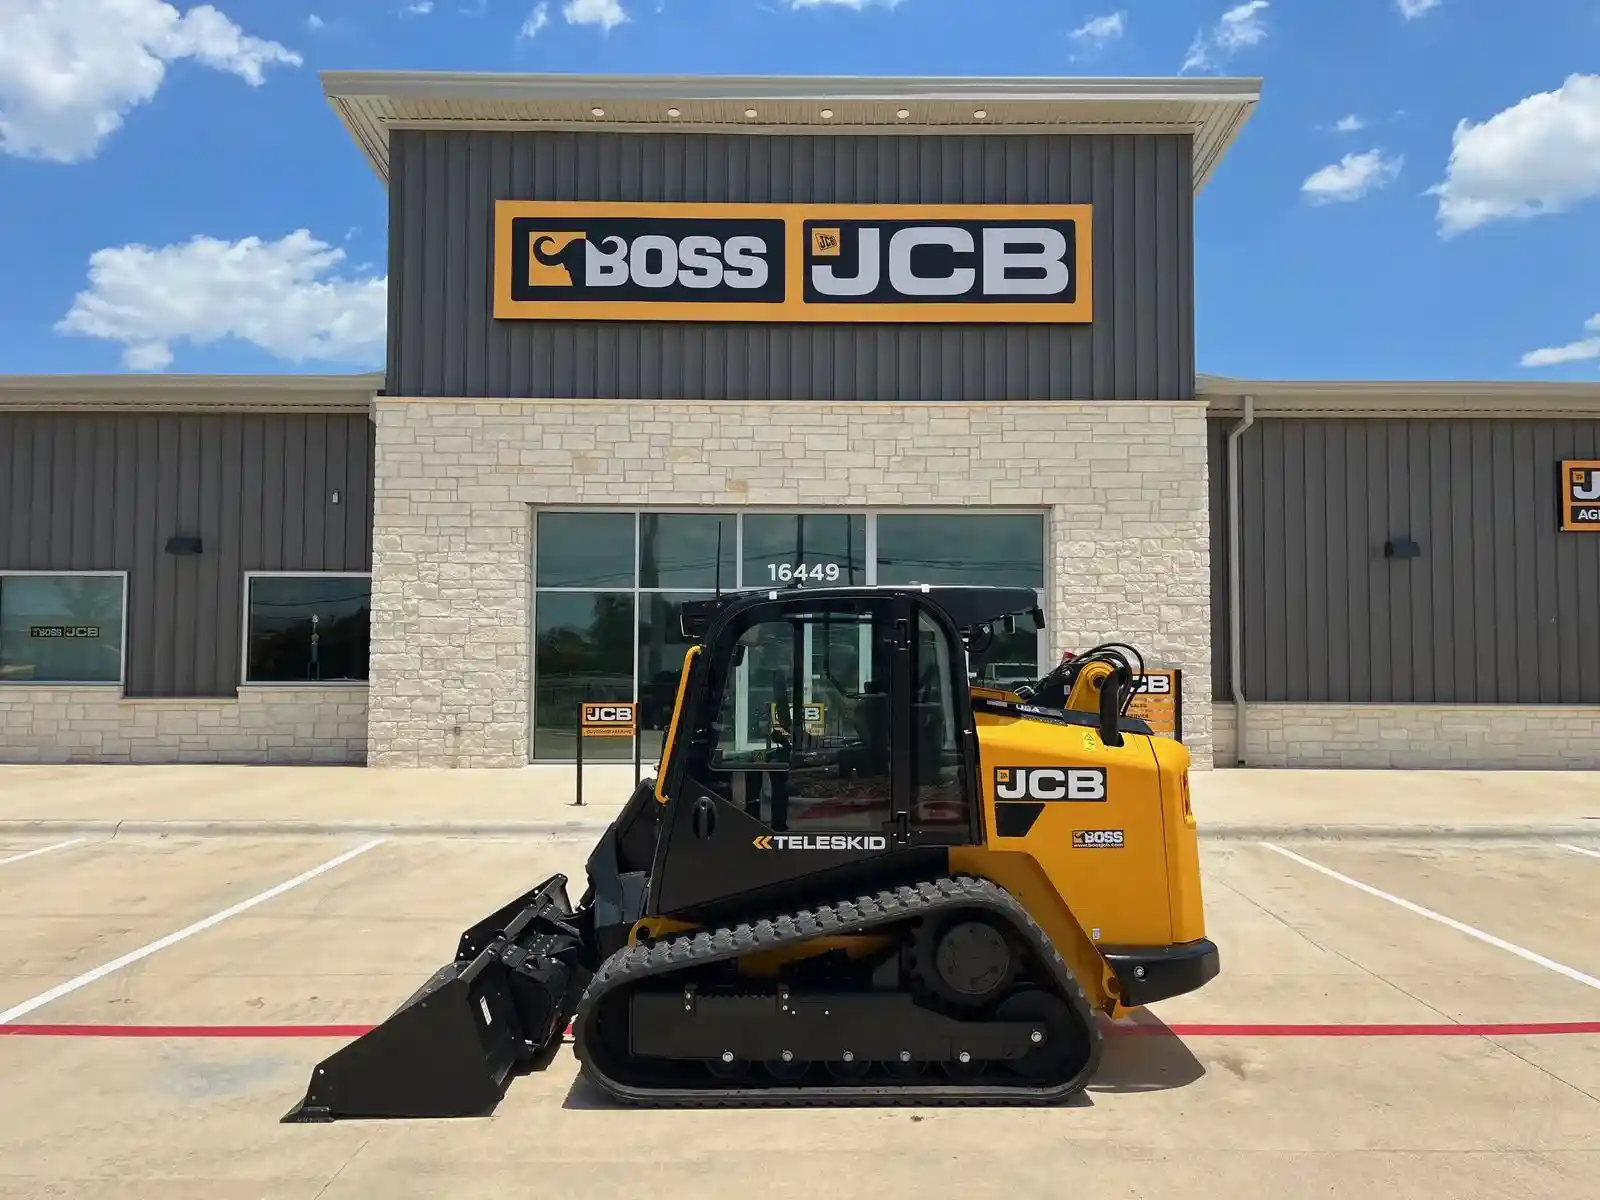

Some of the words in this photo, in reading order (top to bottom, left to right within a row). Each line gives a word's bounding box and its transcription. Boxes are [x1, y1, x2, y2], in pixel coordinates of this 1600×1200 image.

[585, 235, 769, 289] BOSS
[811, 227, 1069, 297] JCB
[1578, 508, 1600, 520] AG
[767, 563, 840, 581] 16449
[39, 628, 62, 637] BOSS
[66, 627, 98, 637] JCB
[1129, 675, 1170, 693] CB
[587, 707, 632, 721] JCB
[997, 769, 1105, 799] JCB
[773, 836, 886, 850] TELESKID
[1084, 831, 1124, 844] BOSS
